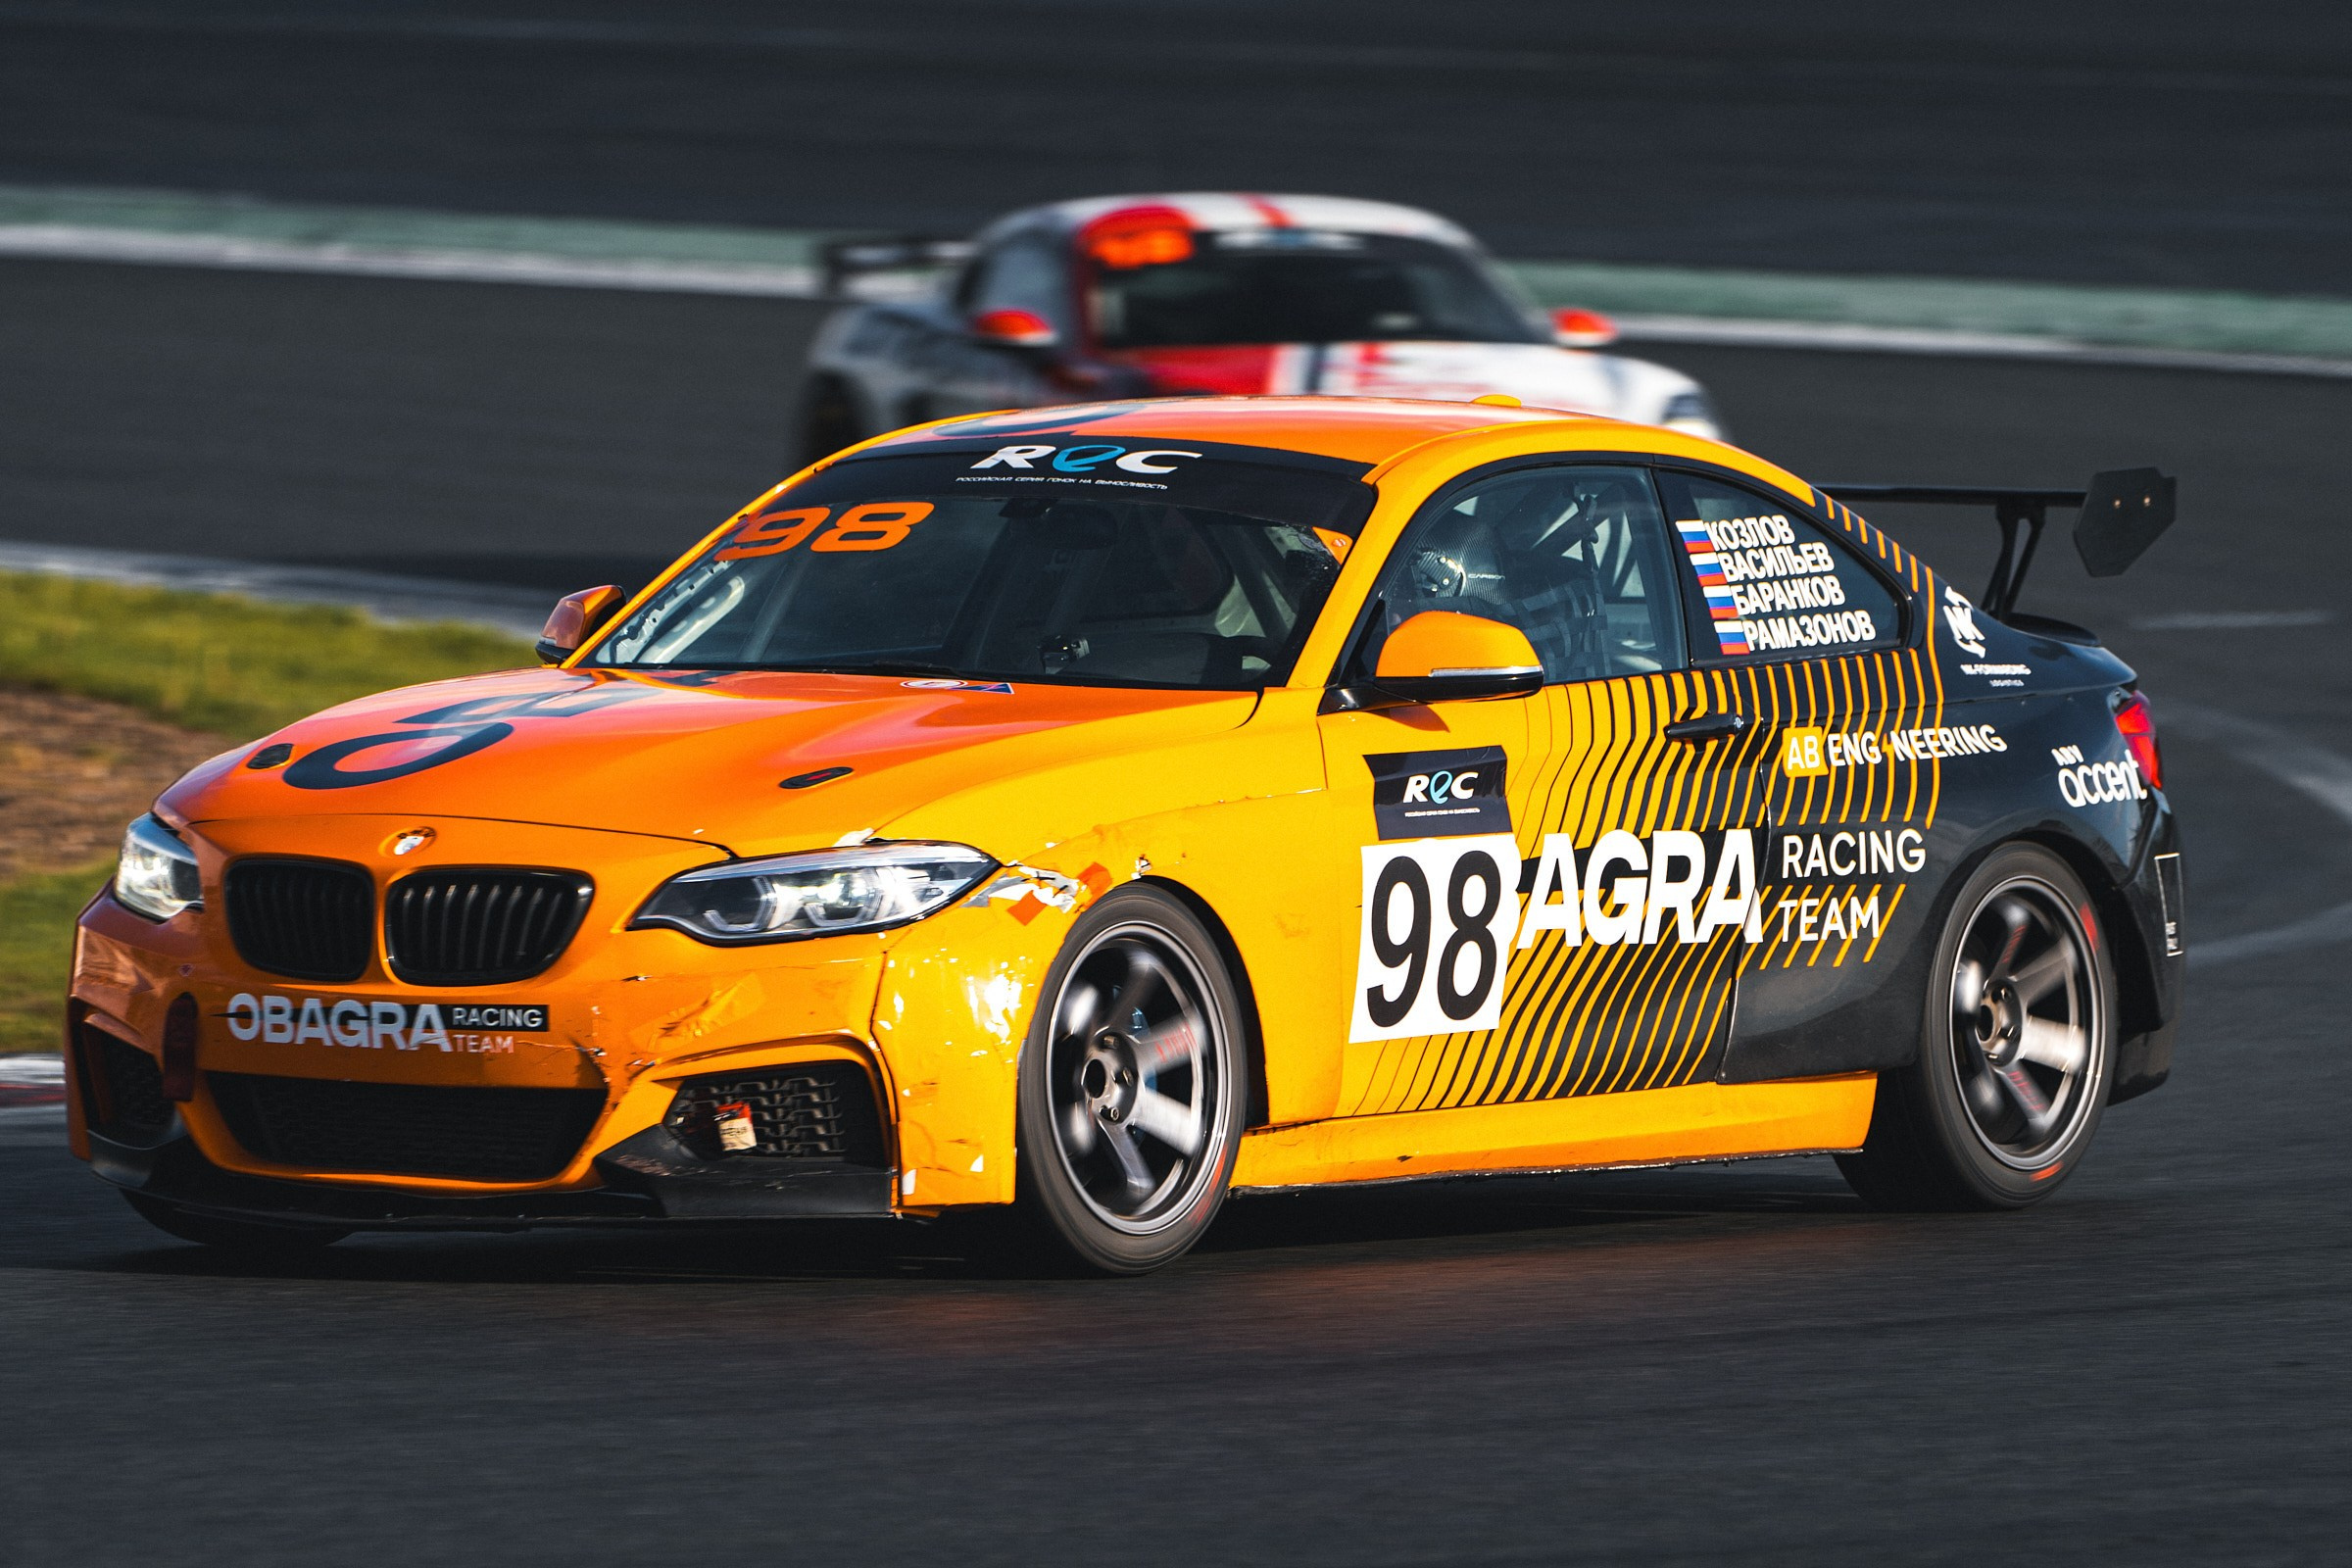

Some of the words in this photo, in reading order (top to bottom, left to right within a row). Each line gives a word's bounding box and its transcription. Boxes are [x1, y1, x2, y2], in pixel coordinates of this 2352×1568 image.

[713, 502, 935, 562] 98
[1703, 514, 1795, 552] КОЗЛОВ
[1717, 541, 1835, 583] ВАСИЛЬЕВ
[1730, 574, 1846, 616] БАРАНКОВ
[1741, 609, 1877, 652] РАМАЗОНОВ
[1787, 735, 1821, 770] AB
[2058, 749, 2148, 808] accent
[1782, 827, 1928, 879] RACING
[1366, 849, 1501, 1028] 98
[1778, 896, 1880, 943] TEAM
[227, 992, 454, 1053] OBAGRA
[453, 1007, 544, 1028] RACING
[454, 1034, 514, 1054] TEAM
